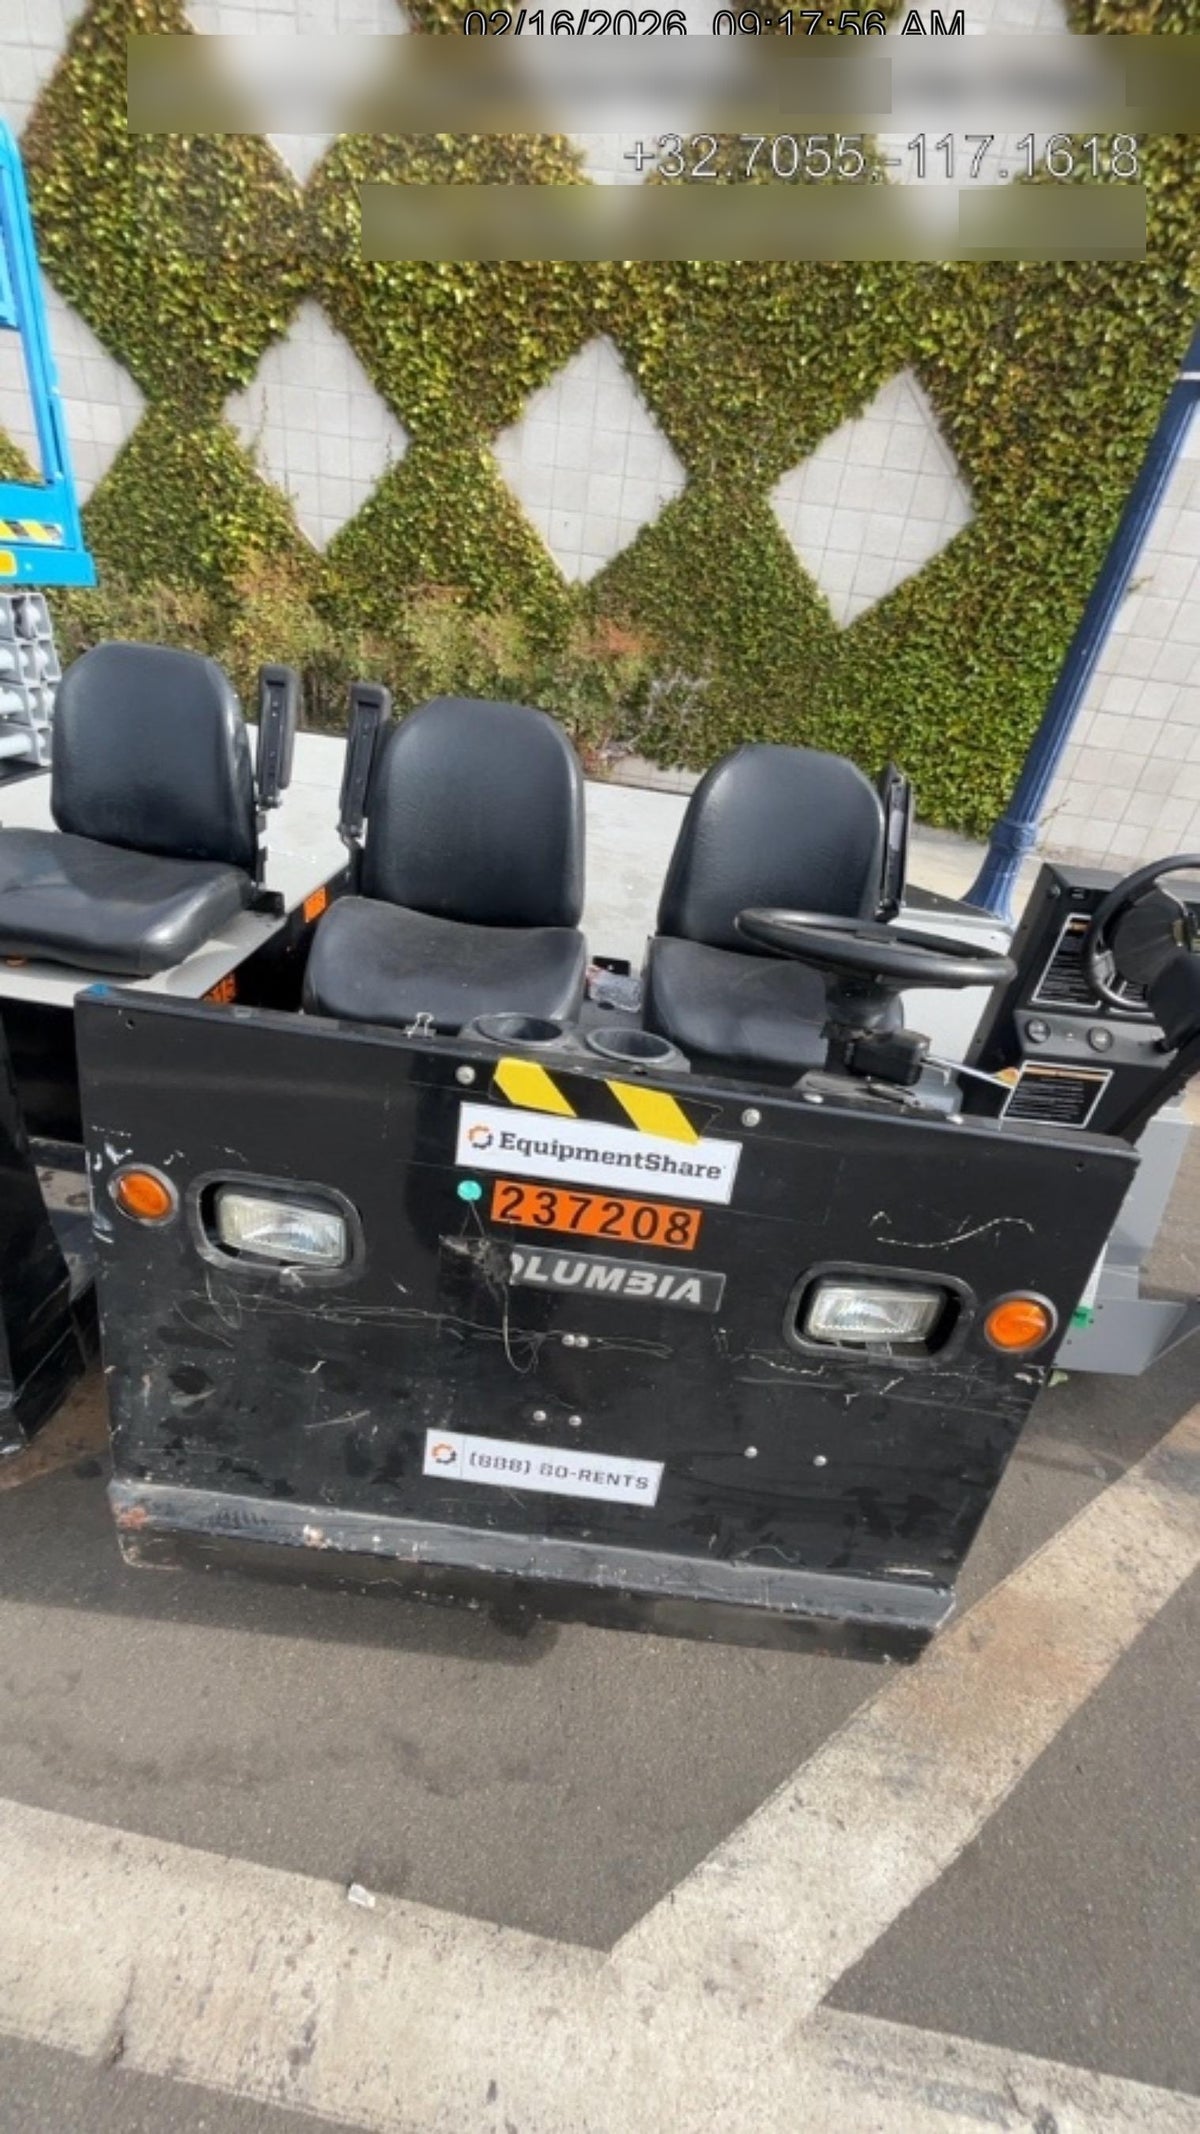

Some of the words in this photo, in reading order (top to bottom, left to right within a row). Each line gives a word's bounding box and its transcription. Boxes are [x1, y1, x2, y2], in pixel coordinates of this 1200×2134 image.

[499, 1131, 722, 1180] EquipmentShare
[499, 1186, 692, 1246] 237208
[468, 1451, 532, 1475] (888)
